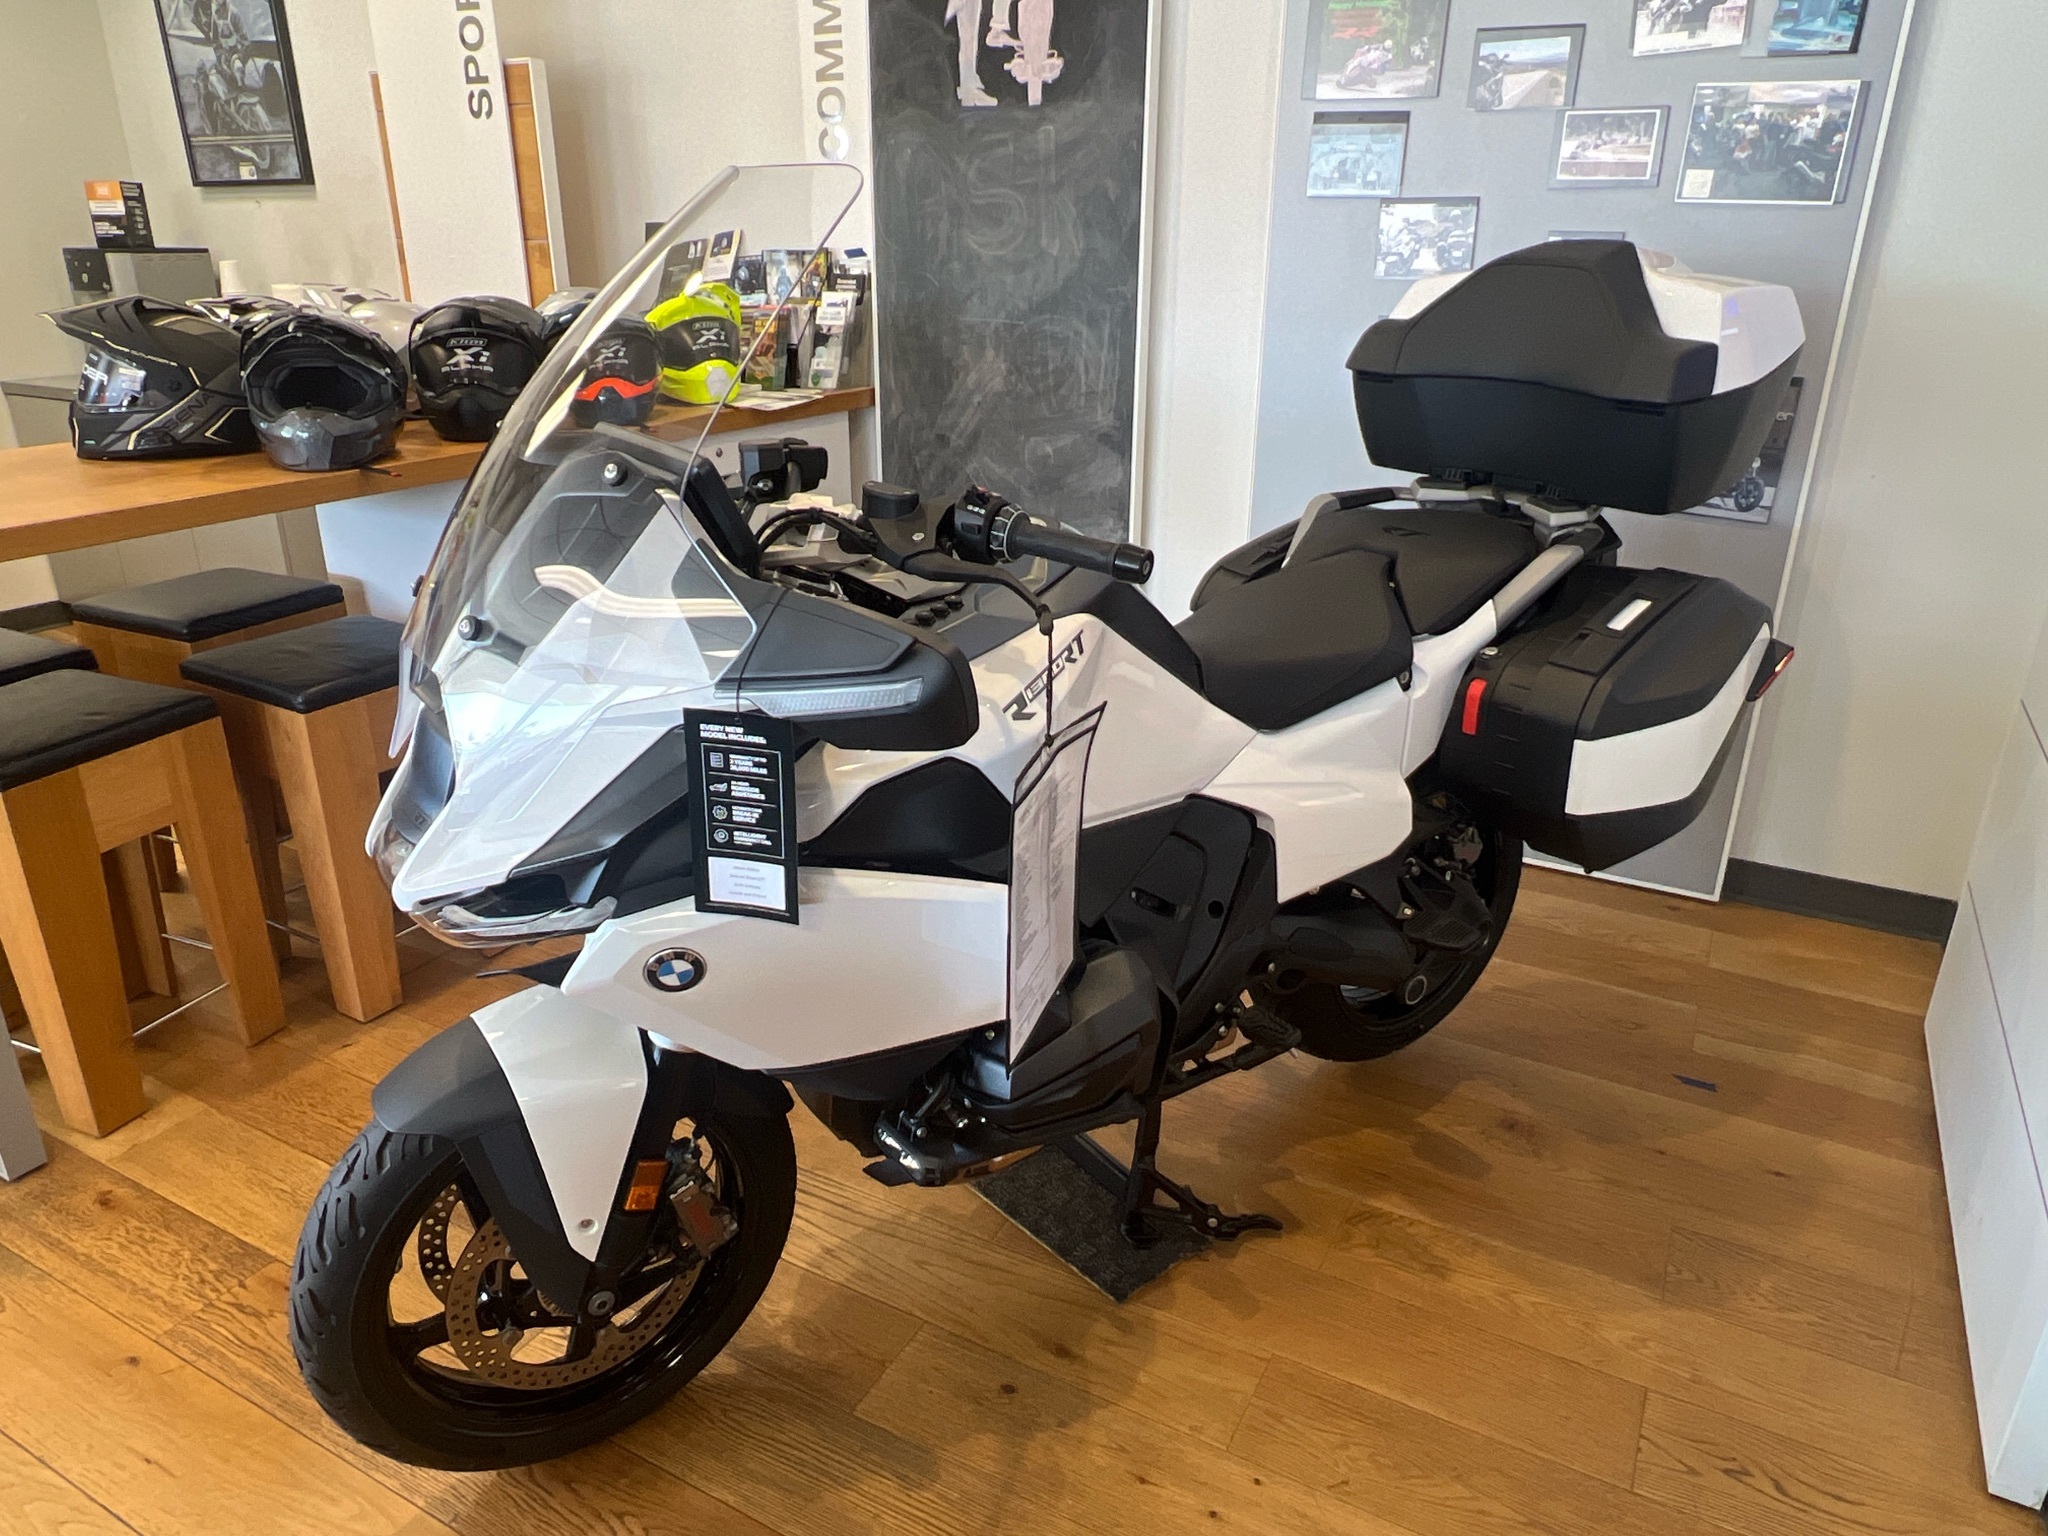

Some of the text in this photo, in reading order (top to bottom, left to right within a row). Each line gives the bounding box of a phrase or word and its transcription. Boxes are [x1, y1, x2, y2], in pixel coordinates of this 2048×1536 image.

[161, 392, 215, 431] SENA
[699, 723, 744, 734] EVERY NEW
[700, 731, 727, 740] MODEL
[647, 951, 696, 971] BMW
